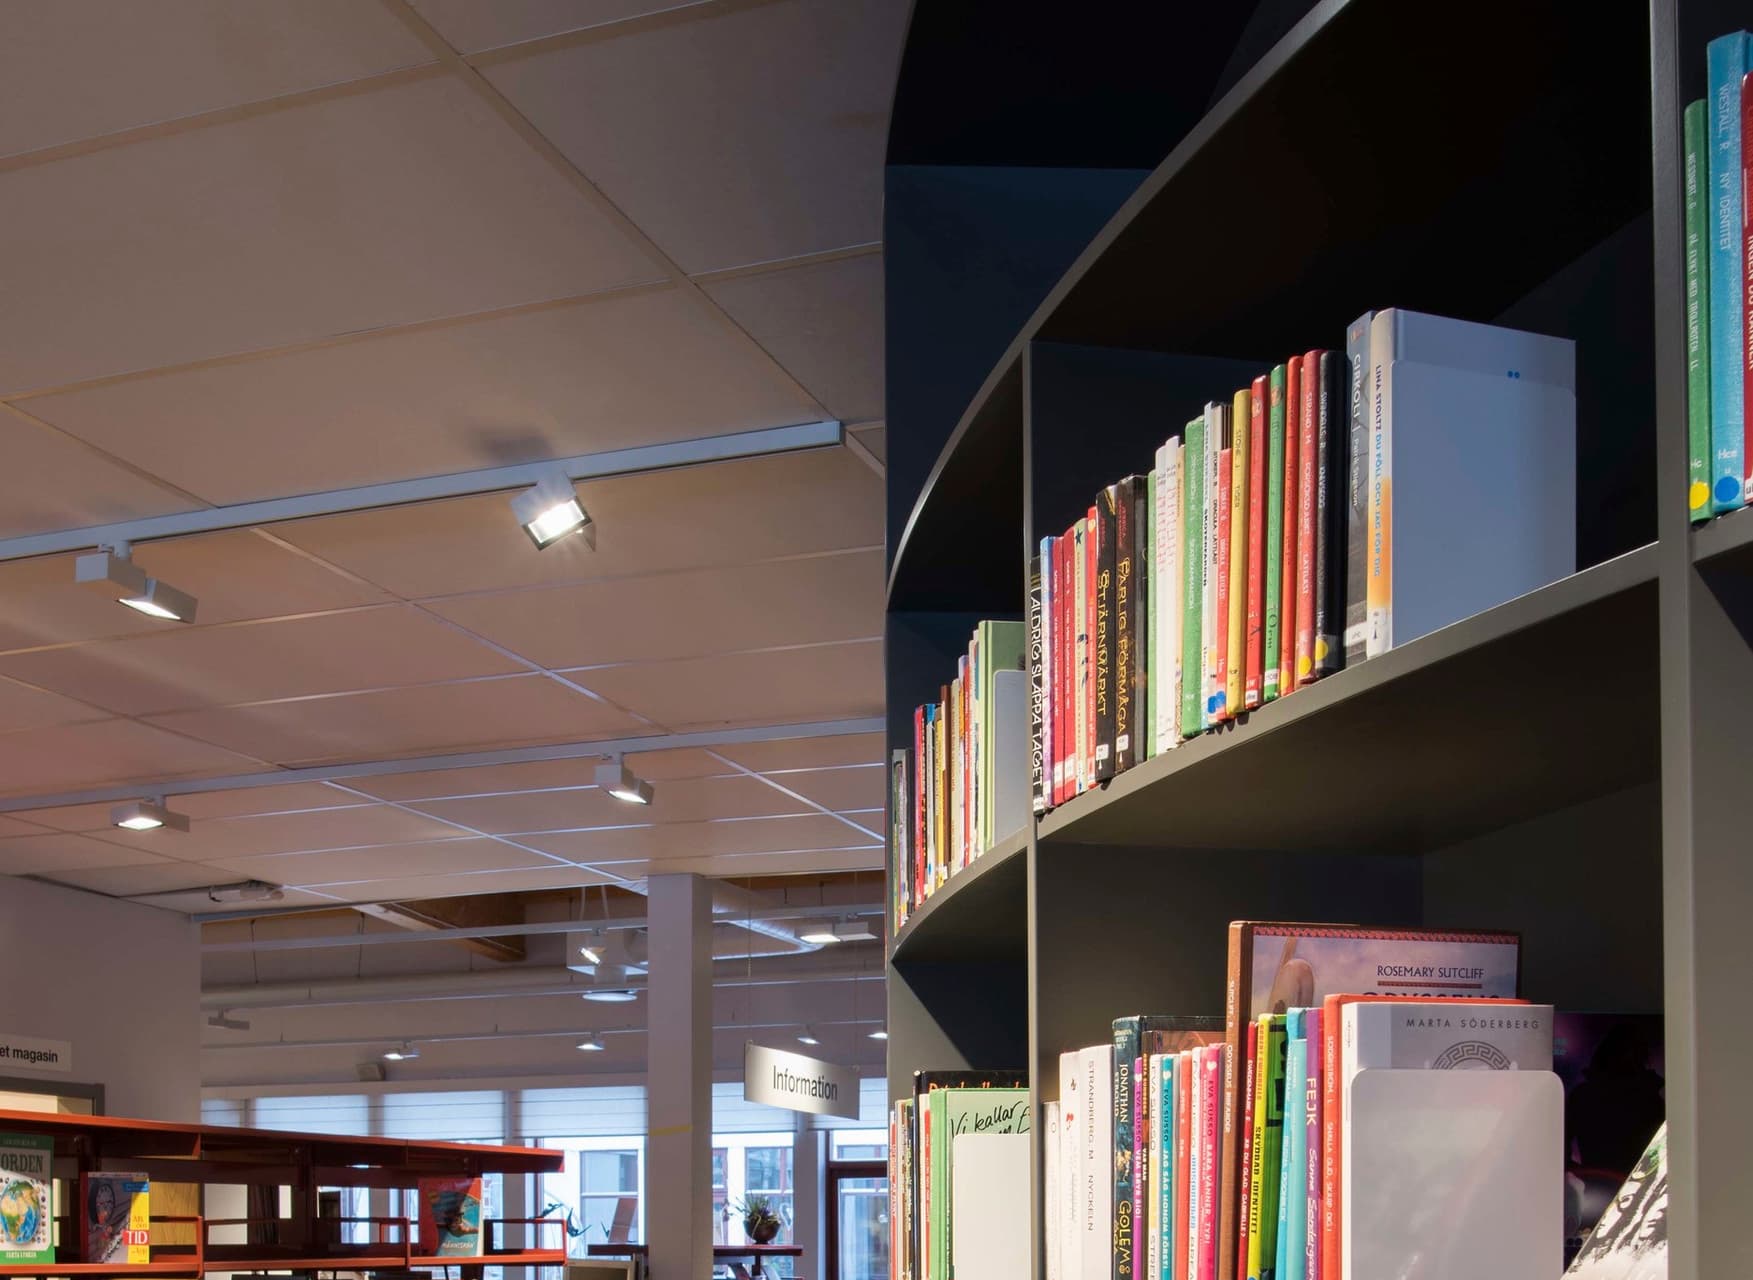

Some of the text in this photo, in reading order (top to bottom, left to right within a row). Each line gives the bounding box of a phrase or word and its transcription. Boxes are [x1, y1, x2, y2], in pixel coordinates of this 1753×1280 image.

[1719, 172, 1730, 188] NY
[1719, 195, 1731, 250] IDENTITET
[1374, 365, 1382, 390] LINA
[1374, 394, 1382, 432] STOLTZ
[1374, 434, 1382, 449] DU
[1374, 483, 1382, 506] OCH
[1030, 597, 1043, 661] ALDRIG
[1096, 570, 1109, 717] STJÄRNMÄRKT
[1117, 558, 1130, 735] FARLIG FÖRMÅGA
[1030, 728, 1043, 788] TAGET
[1377, 965, 1484, 979] ROSEMARY SUTCLIFF
[1406, 1017, 1539, 1030] MARTA SÖDERBERG
[12, 1048, 58, 1065] magasin
[773, 1065, 838, 1101] Information
[1119, 1064, 1129, 1123] JONATHAN
[974, 1100, 1024, 1132] kallar
[1306, 1077, 1317, 1126] FEJK
[1088, 1150, 1095, 1160] M
[1308, 1148, 1318, 1191] Sanne
[1250, 1126, 1262, 1234] SKYDDAD IDENTITET
[126, 1230, 149, 1245] TID
